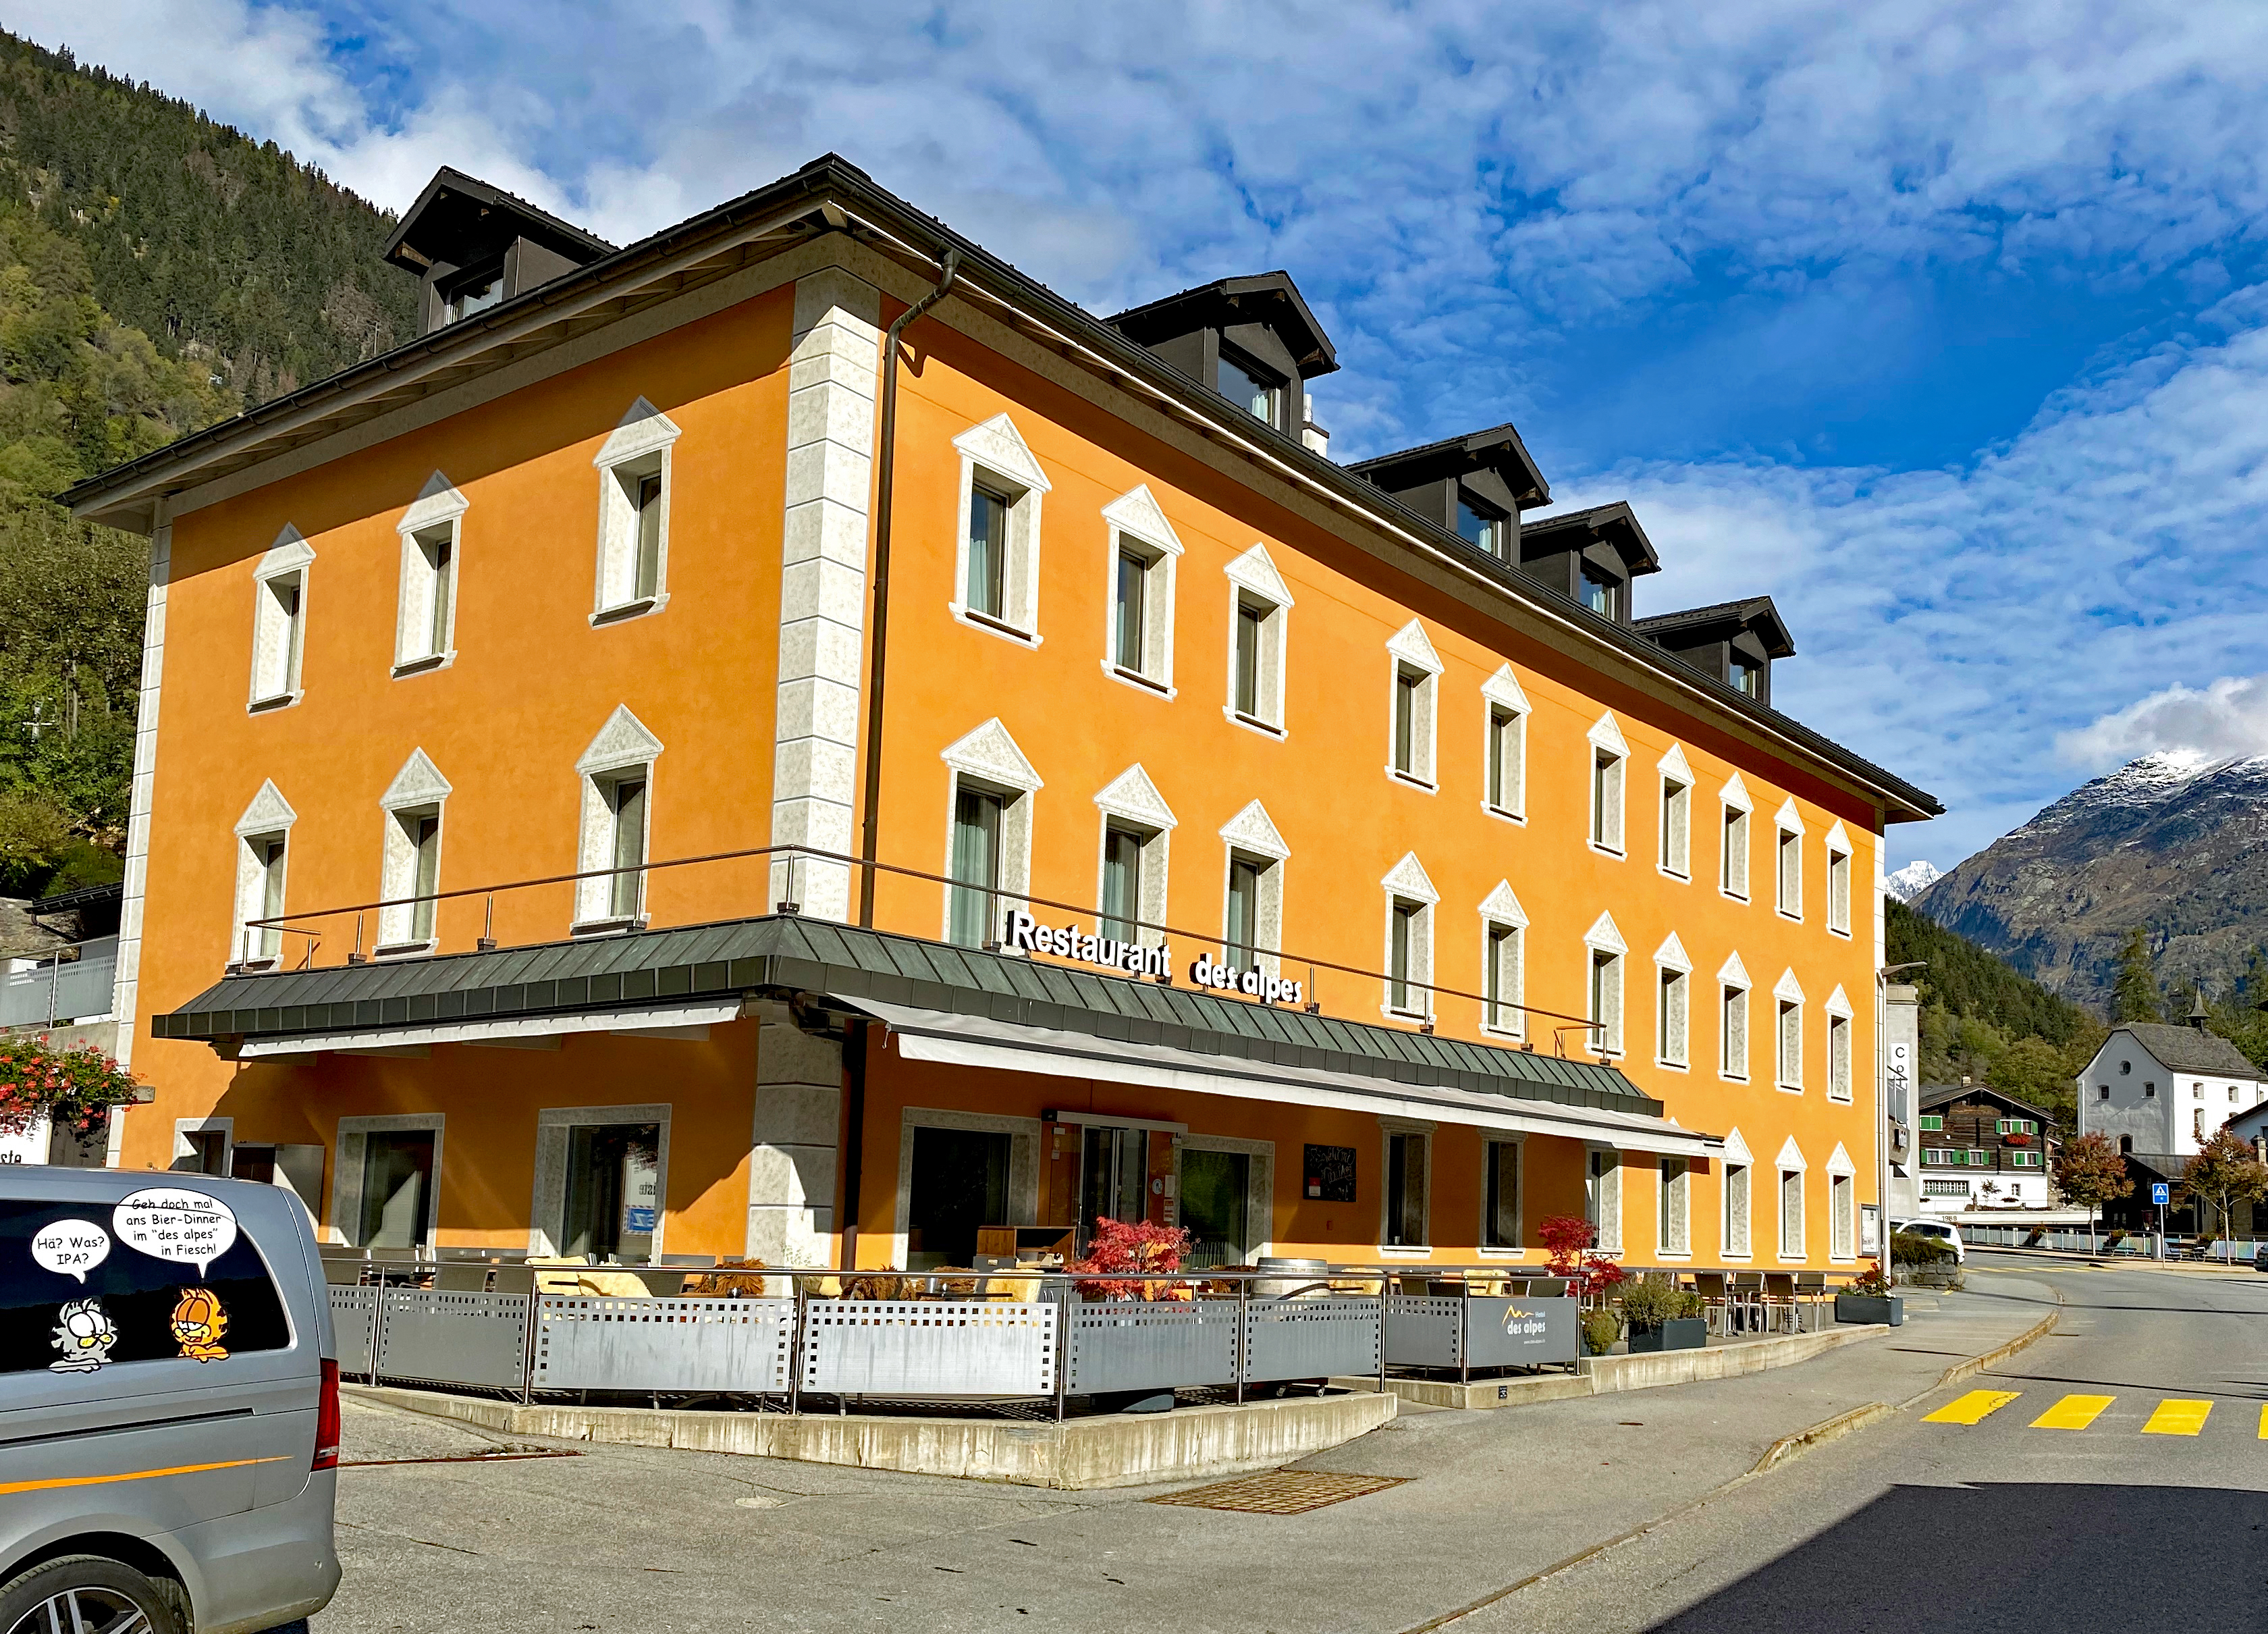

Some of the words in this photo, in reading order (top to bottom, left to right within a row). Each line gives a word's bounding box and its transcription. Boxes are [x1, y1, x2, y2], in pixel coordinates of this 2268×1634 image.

[1006, 910, 1172, 978] Restaurant
[1192, 953, 1237, 990] des
[1240, 965, 1303, 1004] alpes
[132, 1198, 155, 1209] Geh
[161, 1198, 188, 1209] doch
[194, 1198, 213, 1209] mal
[152, 1214, 221, 1225] Bier-Dinner
[134, 1231, 147, 1241] im
[38, 1238, 63, 1249] Hä?
[70, 1236, 105, 1248] Was?
[161, 1245, 171, 1255] in
[176, 1243, 216, 1256] Fiesch!
[57, 1253, 89, 1265] IPA?
[1507, 1320, 1521, 1335] des
[1523, 1319, 1546, 1336] alpes
